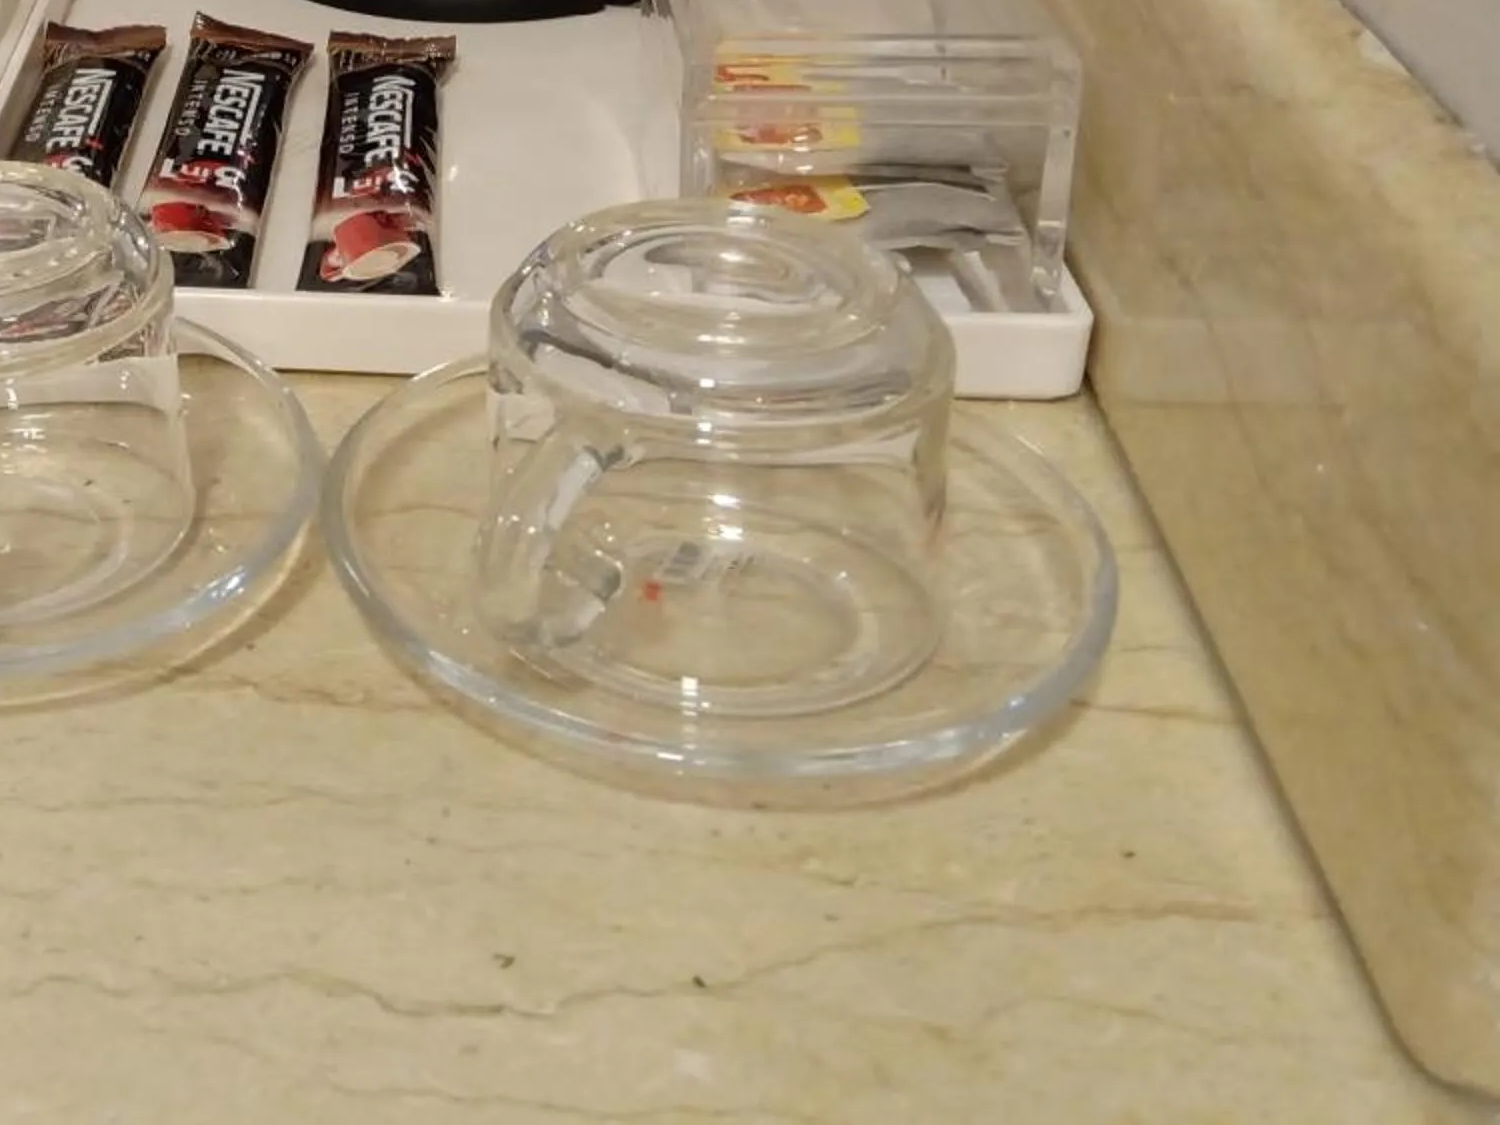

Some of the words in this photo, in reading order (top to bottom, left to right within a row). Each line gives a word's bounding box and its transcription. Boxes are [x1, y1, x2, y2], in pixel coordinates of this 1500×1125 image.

[25, 83, 62, 143] INTENSO
[174, 78, 208, 137] INTENSO
[338, 91, 361, 155] INTENSO
